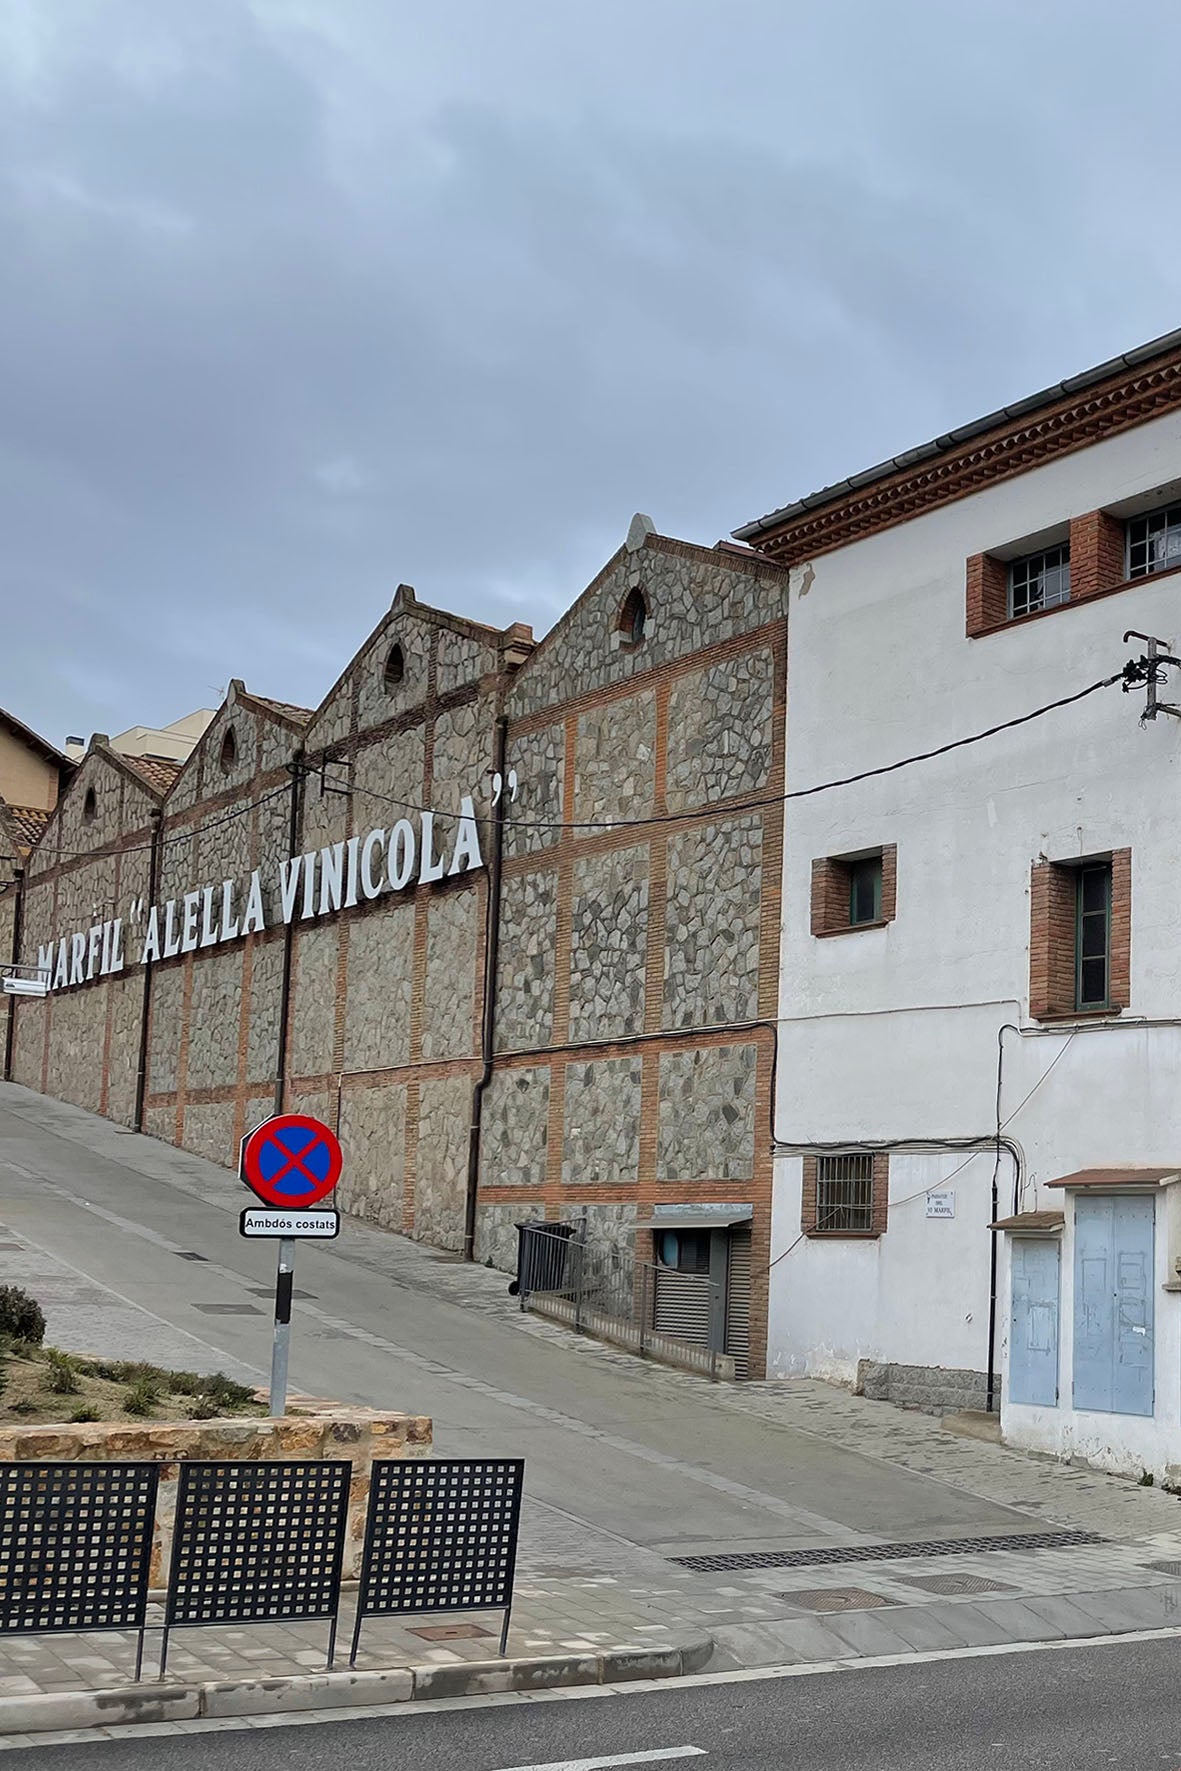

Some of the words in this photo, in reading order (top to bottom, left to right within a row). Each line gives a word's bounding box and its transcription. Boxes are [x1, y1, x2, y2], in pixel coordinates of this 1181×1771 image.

[37, 917, 124, 991] MARFIL
[245, 1218, 292, 1229] Ambdós
[295, 1219, 335, 1230] costats
